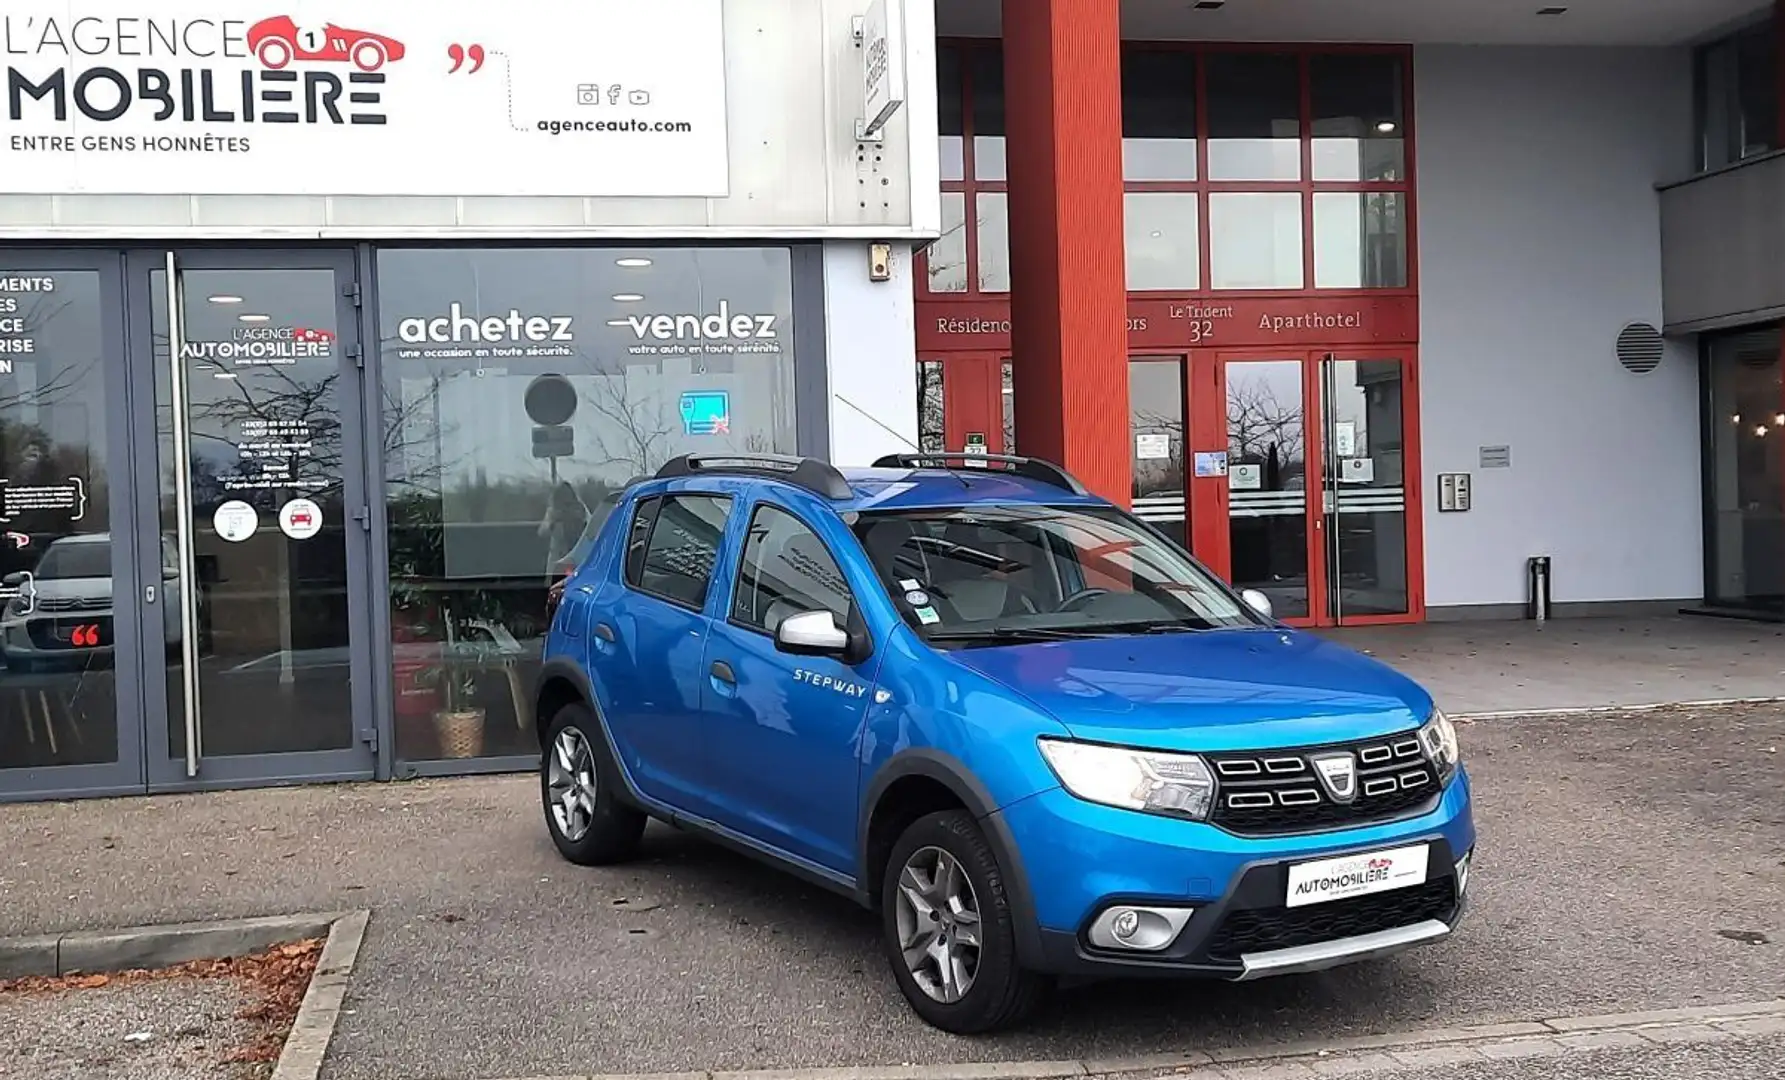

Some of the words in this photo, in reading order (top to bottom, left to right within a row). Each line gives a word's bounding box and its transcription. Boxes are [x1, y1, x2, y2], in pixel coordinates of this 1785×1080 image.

[6, 16, 245, 57] L'AGENCE
[537, 119, 692, 135] agenceauto.com
[11, 136, 75, 152] ENTRE
[82, 136, 136, 152] GENS
[143, 133, 250, 152] HONNÊTES
[1170, 306, 1183, 318] Le
[1186, 305, 1233, 318] Trident
[400, 302, 573, 342] achetez
[628, 301, 776, 338] vendez
[1259, 311, 1361, 333] Aparthotel
[233, 329, 293, 340] L'AGENCE
[1190, 321, 1213, 342] 32
[424, 347, 472, 357] occasion
[493, 347, 523, 356] toute
[629, 345, 657, 354] votre
[660, 345, 685, 354] auto
[706, 344, 733, 353] toute
[793, 669, 866, 698] STEPWAY
